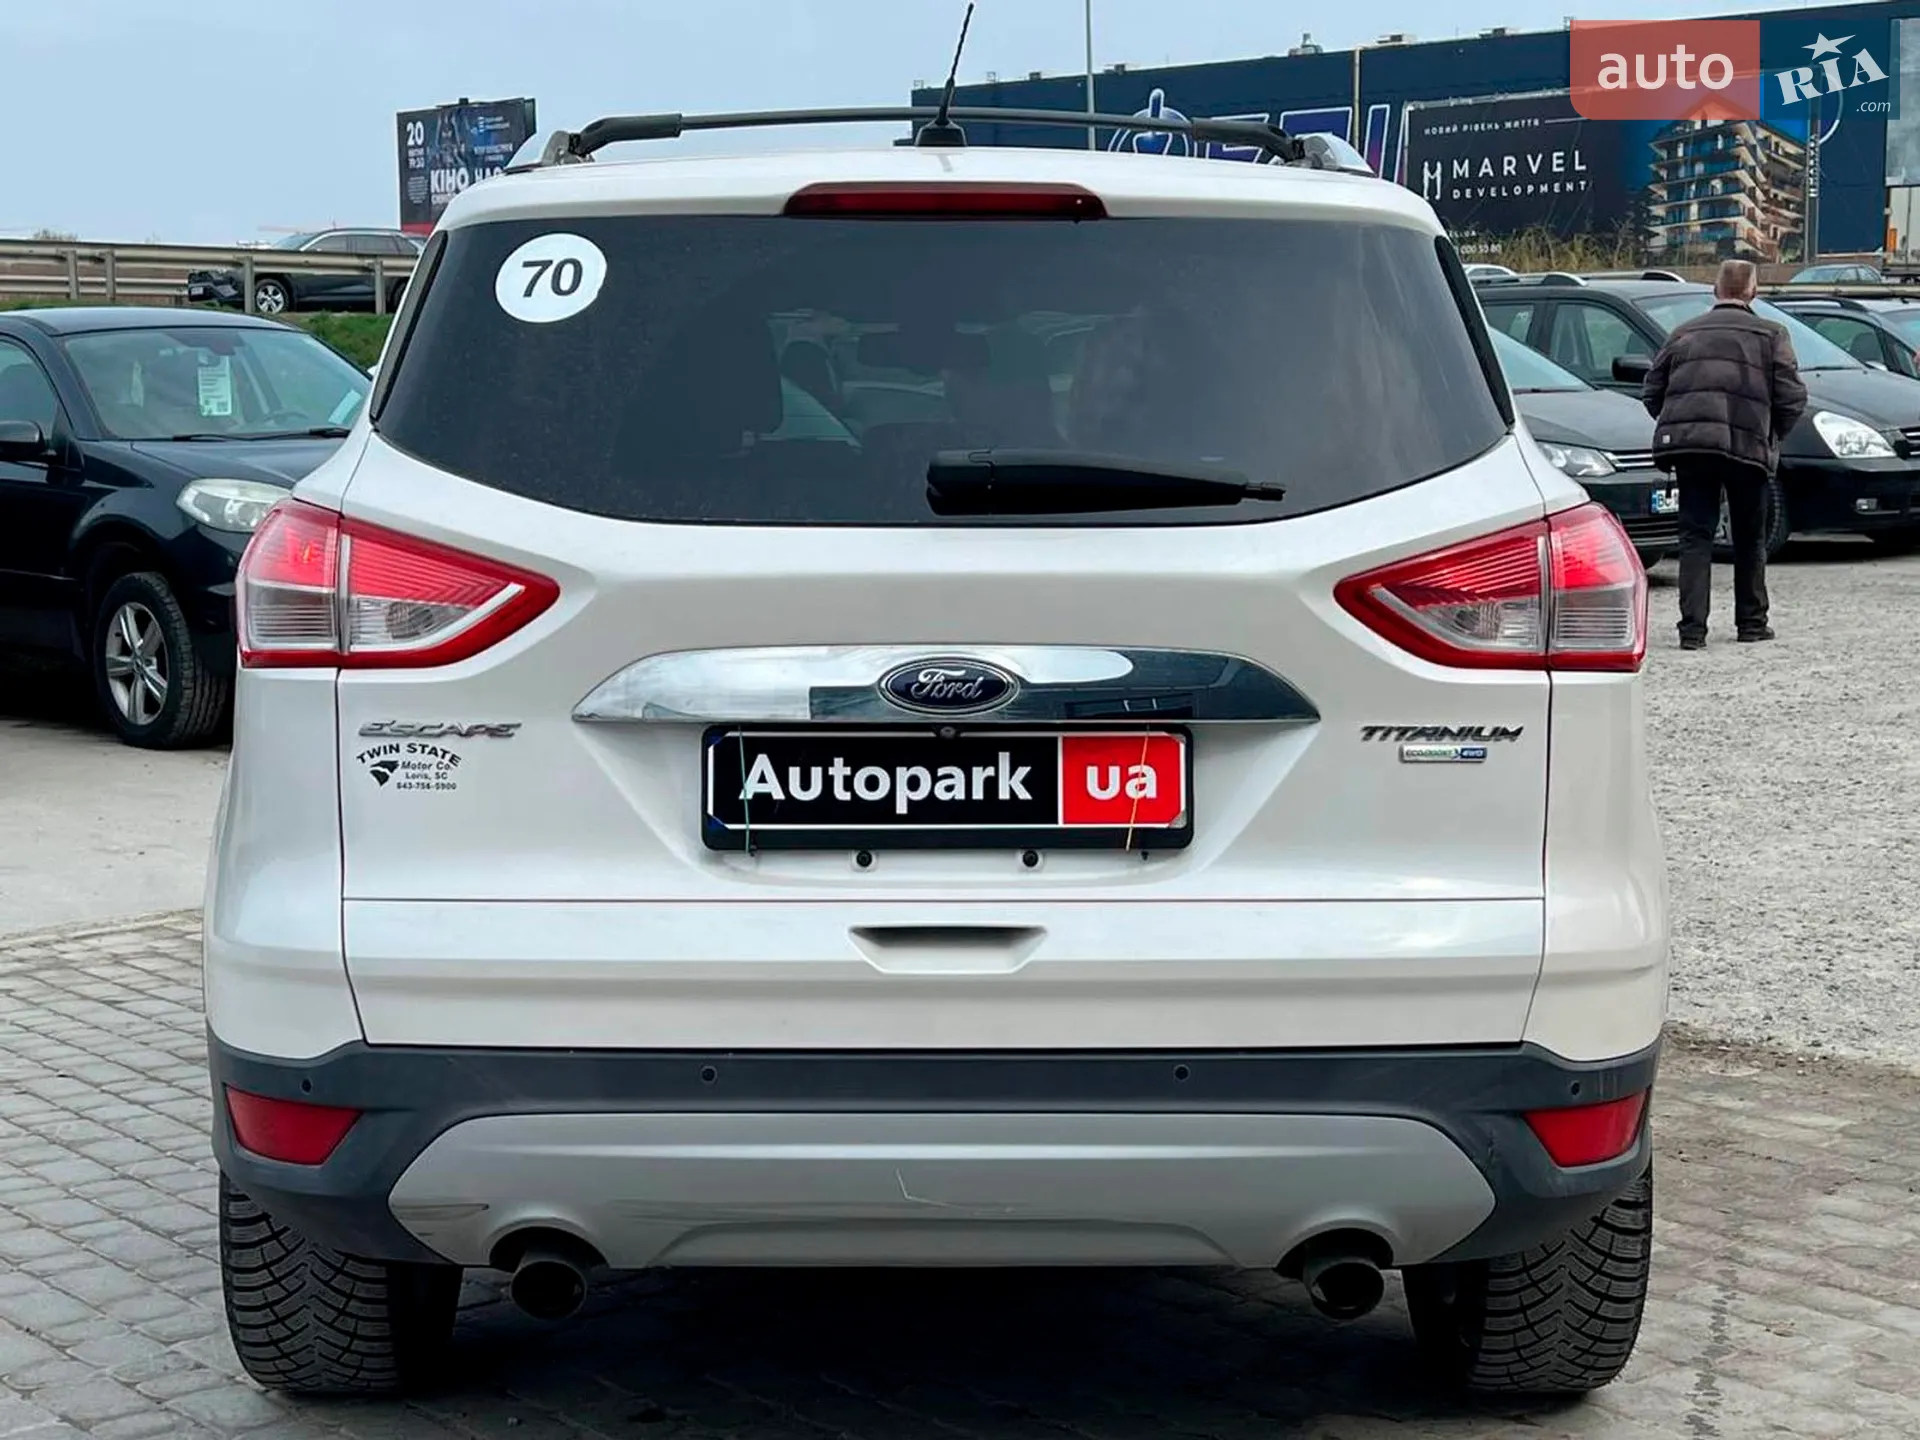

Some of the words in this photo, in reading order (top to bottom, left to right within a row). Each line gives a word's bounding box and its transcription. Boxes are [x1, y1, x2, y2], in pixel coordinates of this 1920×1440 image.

[406, 121, 425, 146] 20
[1452, 149, 1587, 179] MARVEL
[1452, 180, 1588, 200] DEVELOPMENT
[522, 257, 583, 298] 70
[911, 667, 984, 699] Ford
[358, 720, 522, 738] ESCAPE
[1360, 725, 1525, 742] TITANIUM
[356, 743, 400, 764] TWIN
[406, 742, 462, 767] STATE
[401, 761, 433, 771] Motor
[435, 772, 449, 780] SC
[738, 751, 1033, 815] Autopark
[1085, 763, 1158, 800] ua
